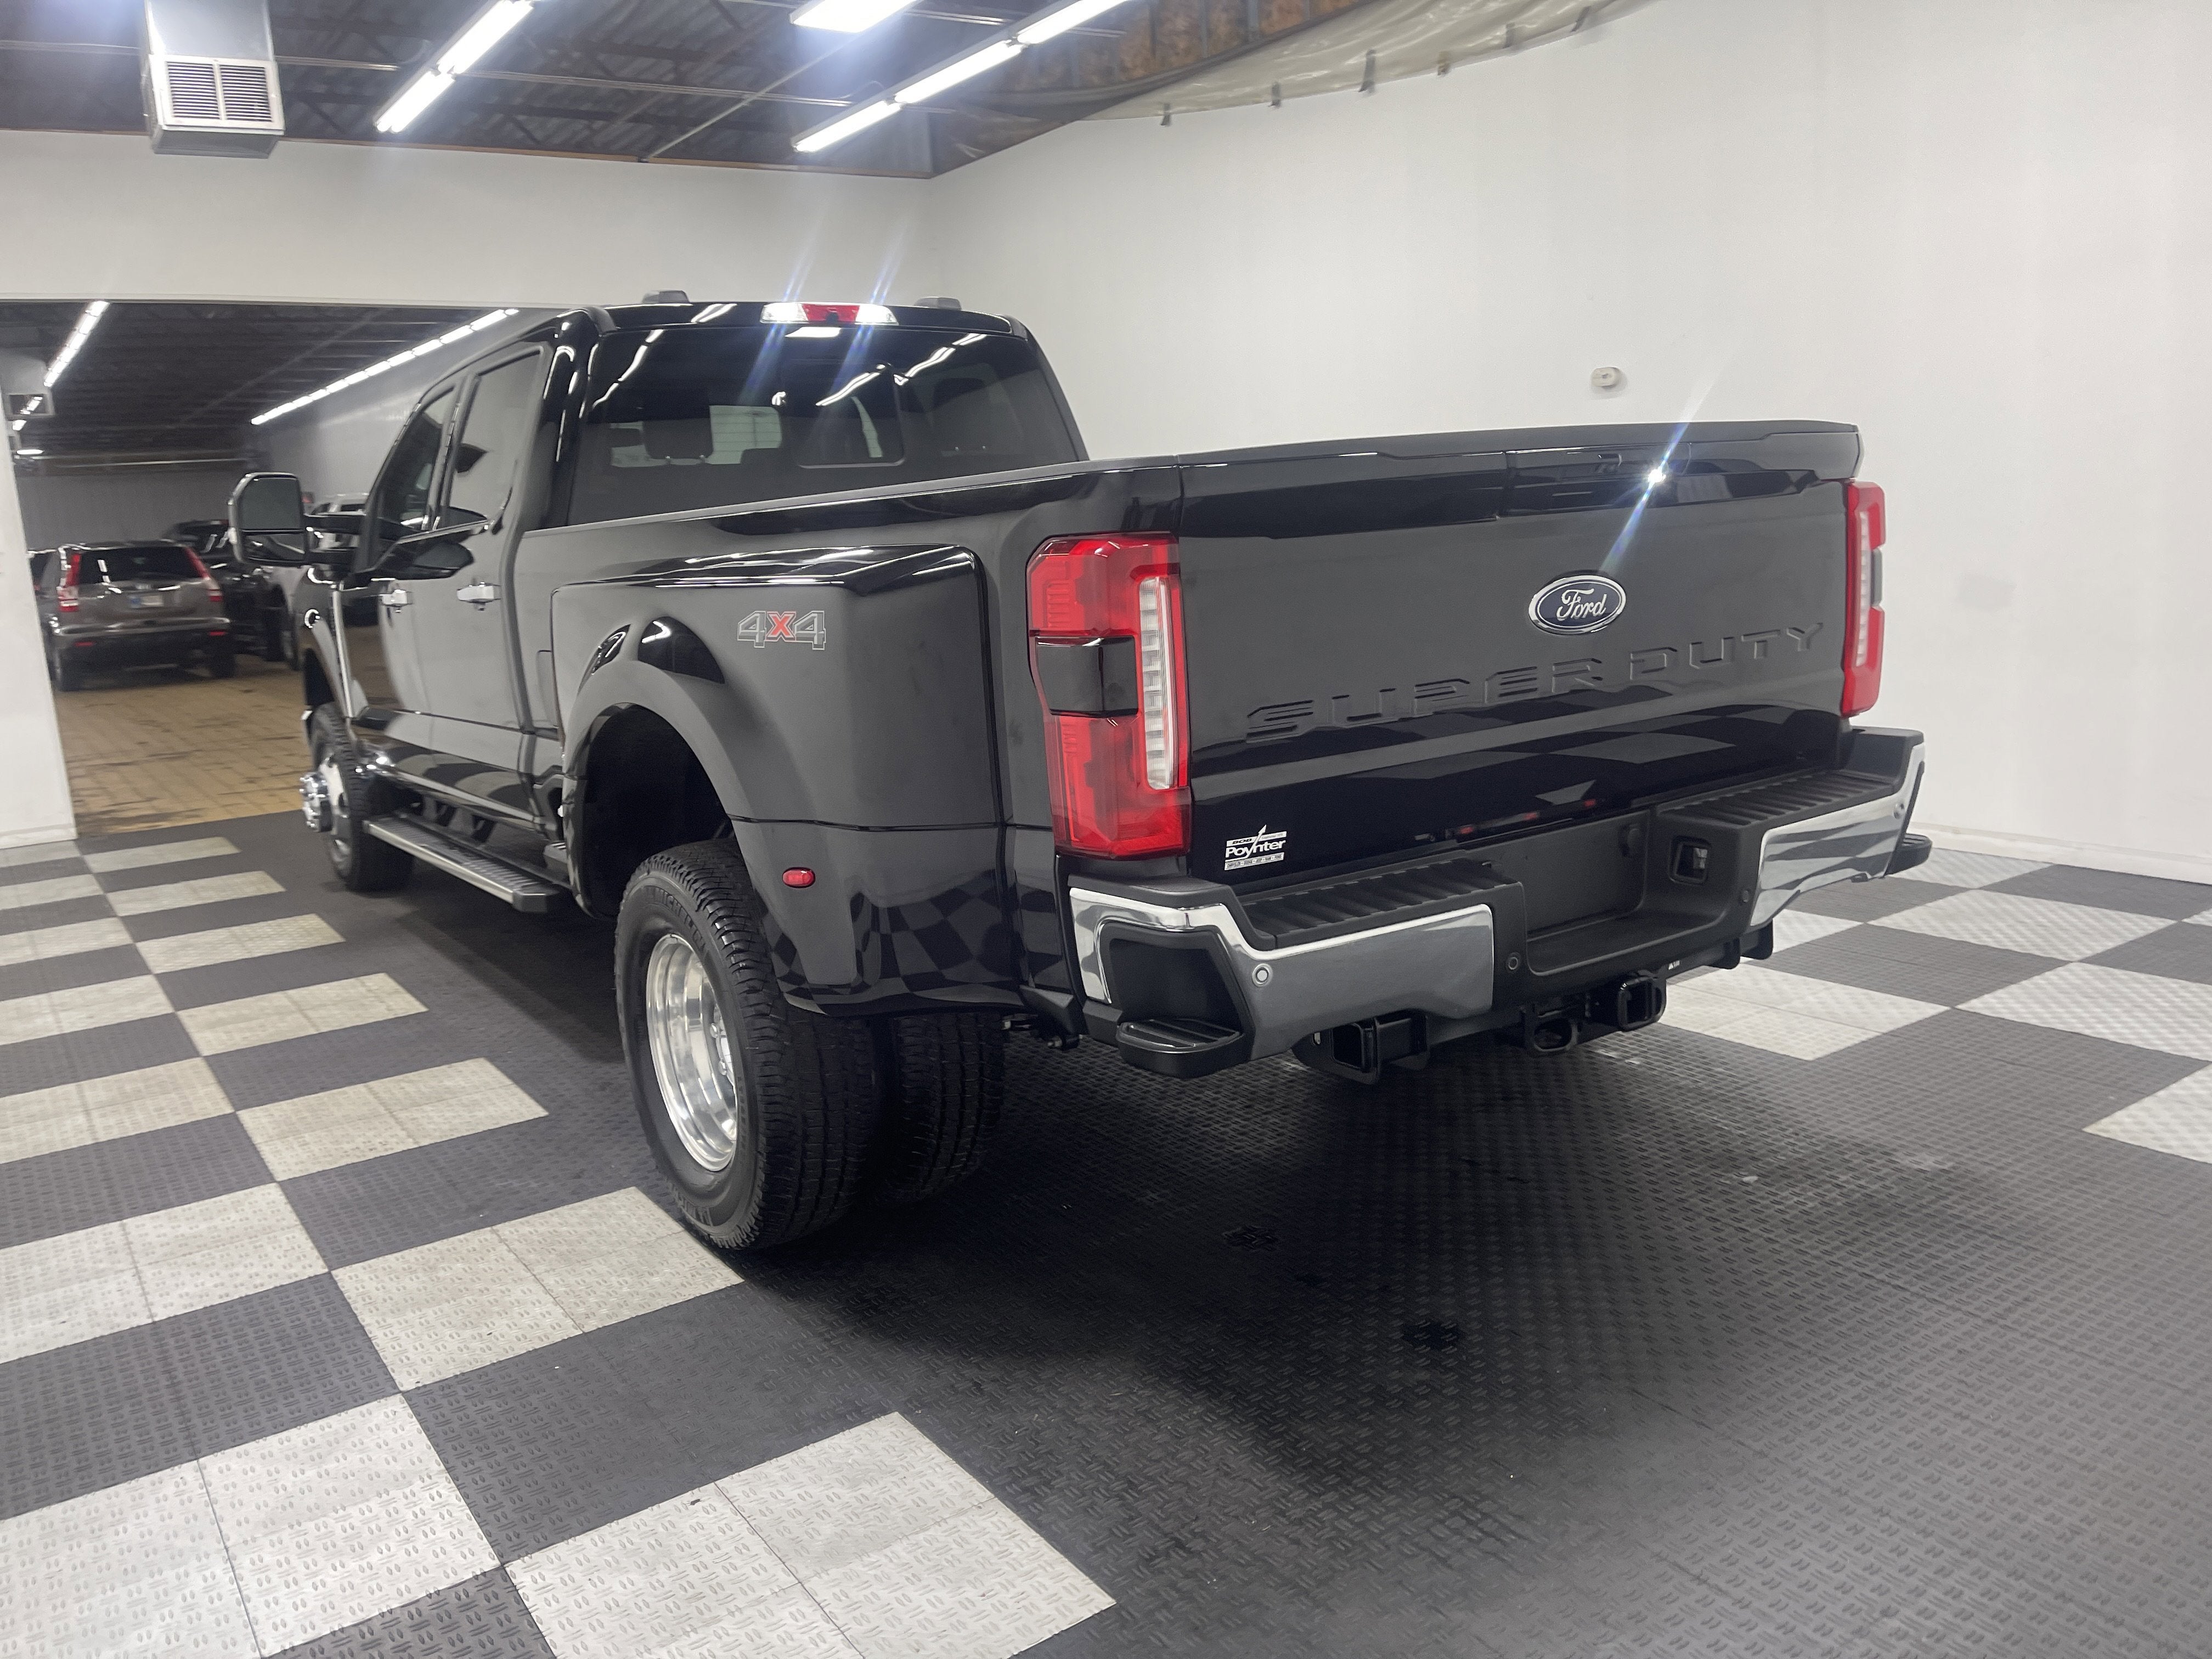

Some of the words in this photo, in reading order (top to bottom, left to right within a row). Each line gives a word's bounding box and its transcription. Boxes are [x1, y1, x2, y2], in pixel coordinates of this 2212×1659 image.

[1556, 588, 1607, 622] Ford
[1246, 658, 1604, 743] SUPER
[1630, 622, 1824, 680] DUTY
[1225, 839, 1286, 860] Poynter
